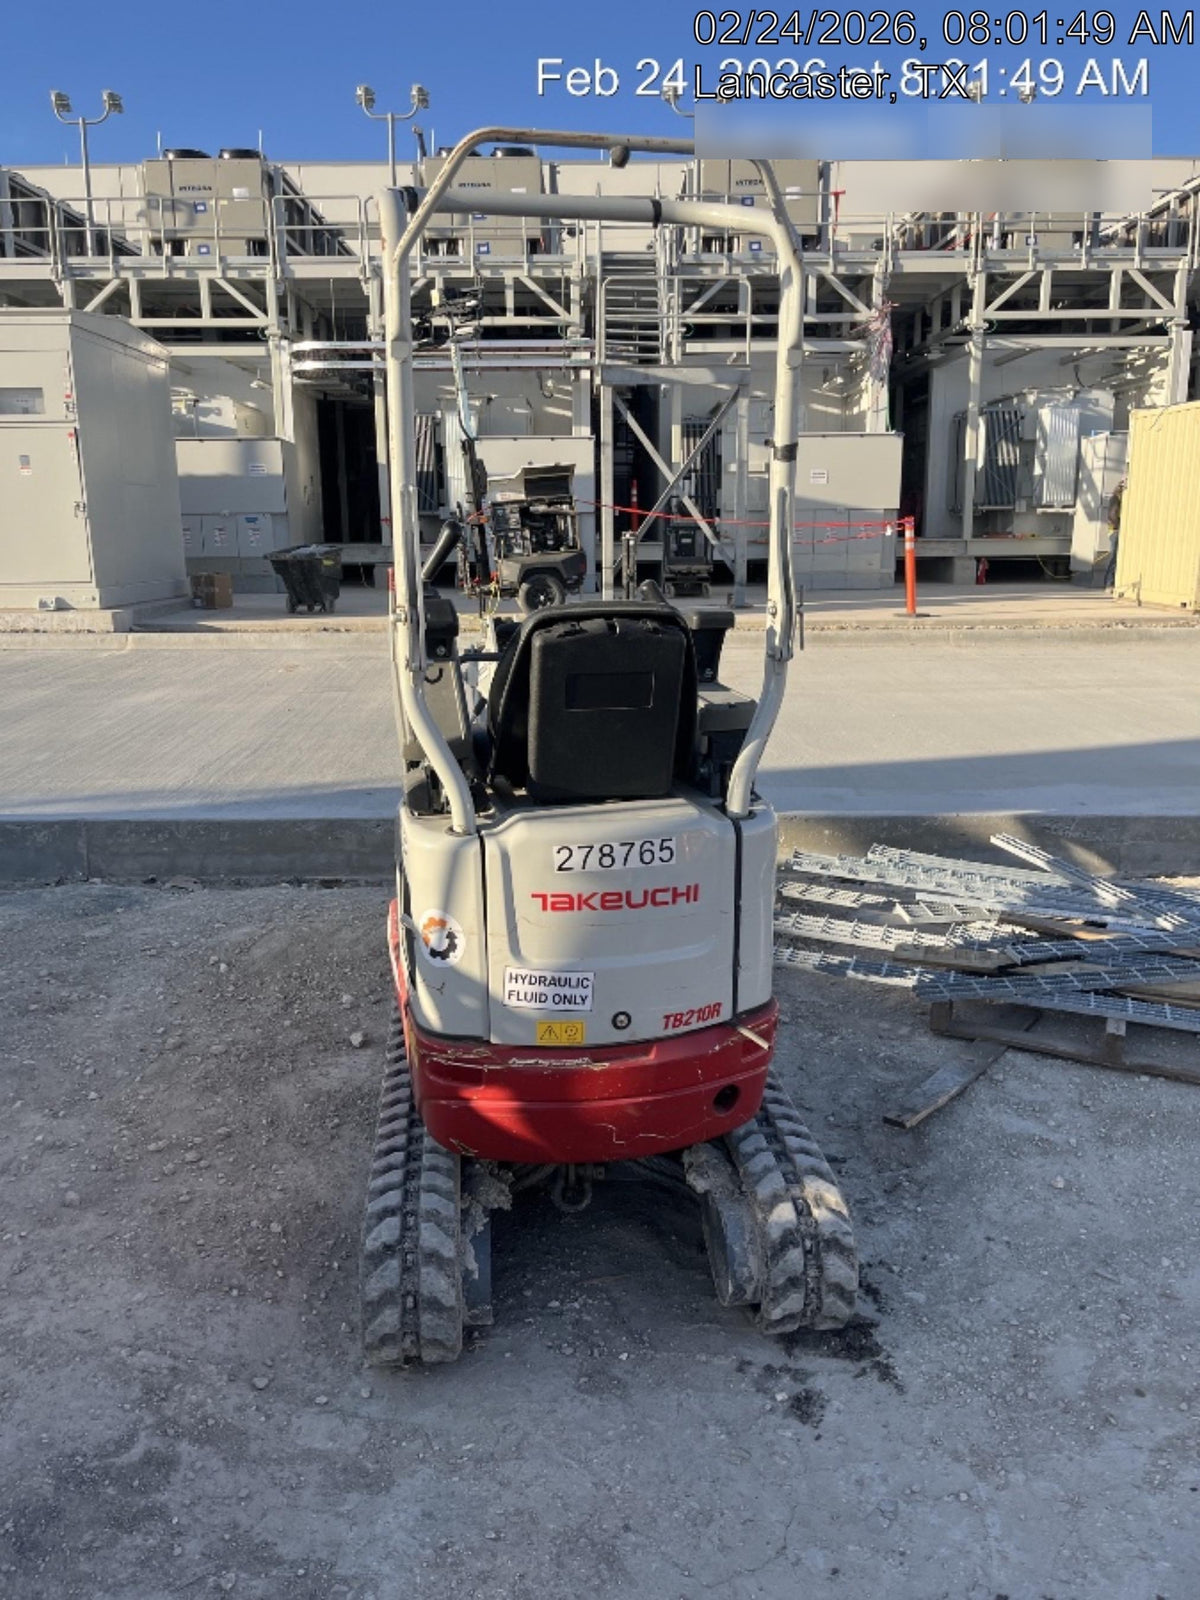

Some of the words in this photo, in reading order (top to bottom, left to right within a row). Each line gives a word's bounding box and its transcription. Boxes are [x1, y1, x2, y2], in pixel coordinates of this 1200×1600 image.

[556, 838, 676, 872] 278765
[508, 972, 591, 989] HYDRAULIC
[507, 989, 548, 1004] FLUID
[552, 993, 589, 1006] ONLY
[663, 1002, 723, 1030] TB210R
